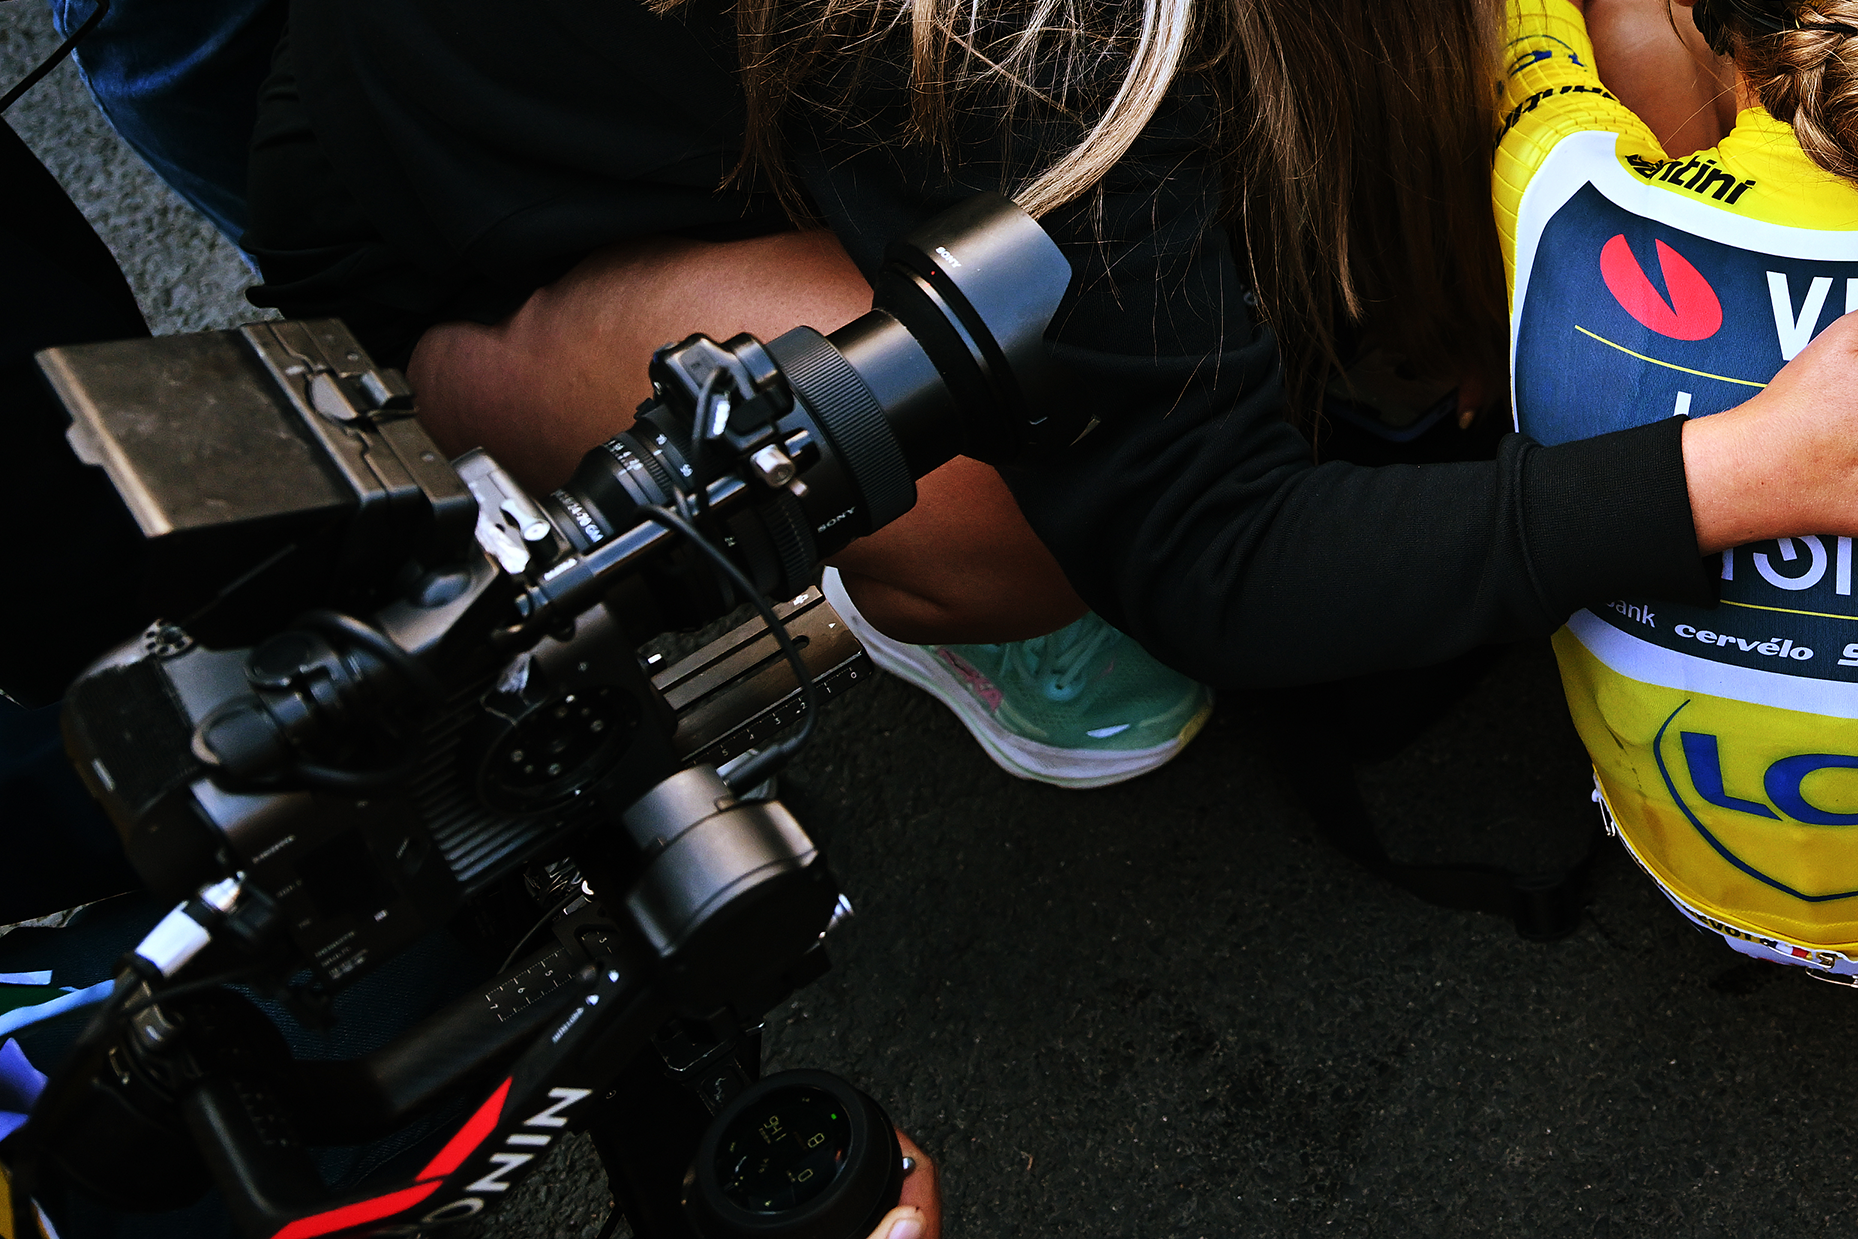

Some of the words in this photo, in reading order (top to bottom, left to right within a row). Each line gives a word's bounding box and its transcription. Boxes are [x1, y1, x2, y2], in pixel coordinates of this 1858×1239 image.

[935, 246, 962, 268] SONY
[817, 505, 857, 534] SONY
[1674, 623, 1815, 661] cervélo
